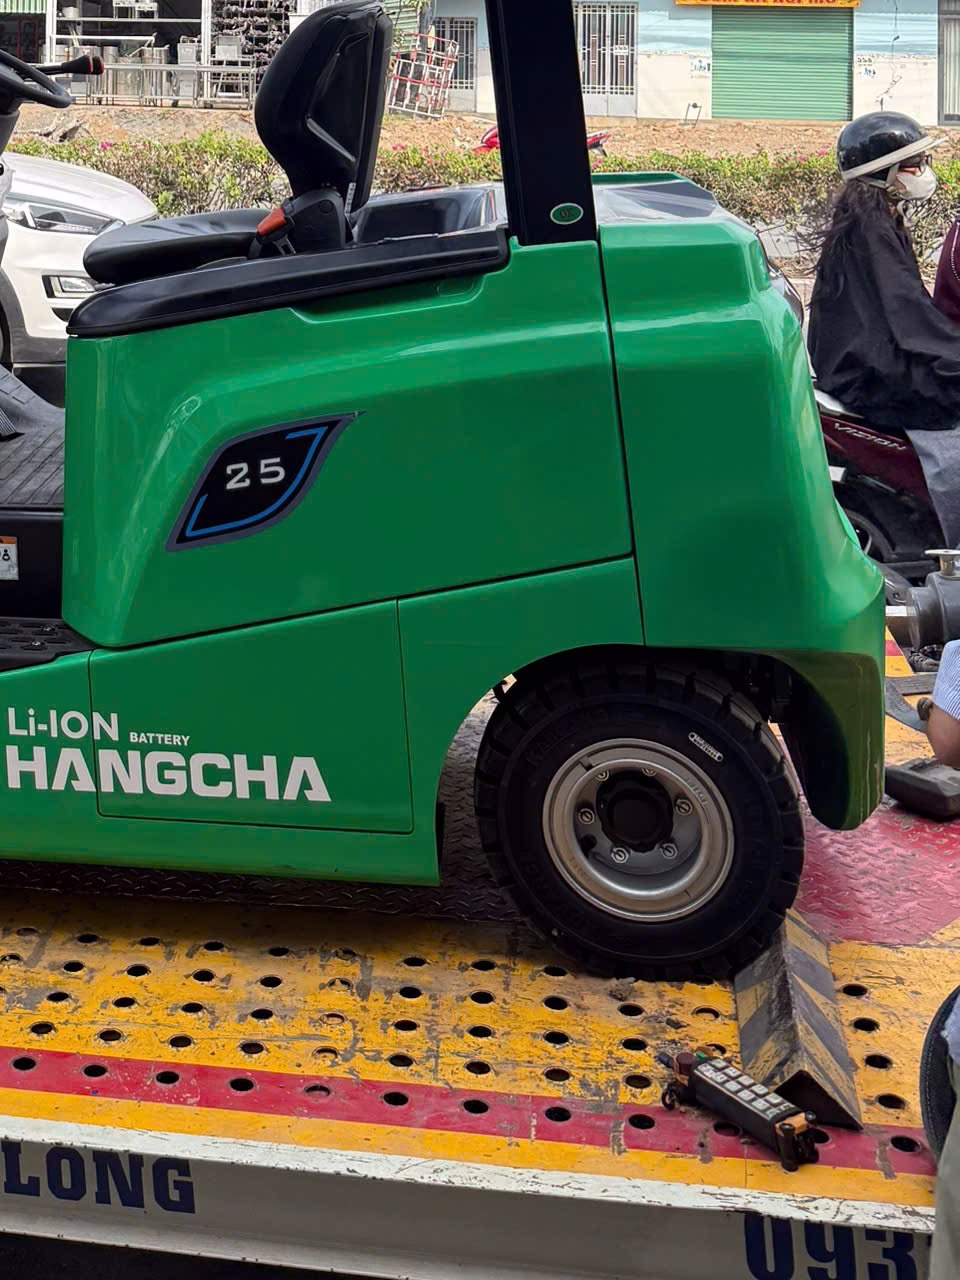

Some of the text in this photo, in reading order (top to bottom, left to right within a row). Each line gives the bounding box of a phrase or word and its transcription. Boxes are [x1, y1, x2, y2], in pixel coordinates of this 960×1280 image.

[225, 457, 286, 490] 25
[7, 707, 190, 747] Li-ION BATTERY
[5, 744, 332, 802] HANGCHA
[1, 1140, 195, 1214] LONG
[744, 1214, 918, 1280] 093
